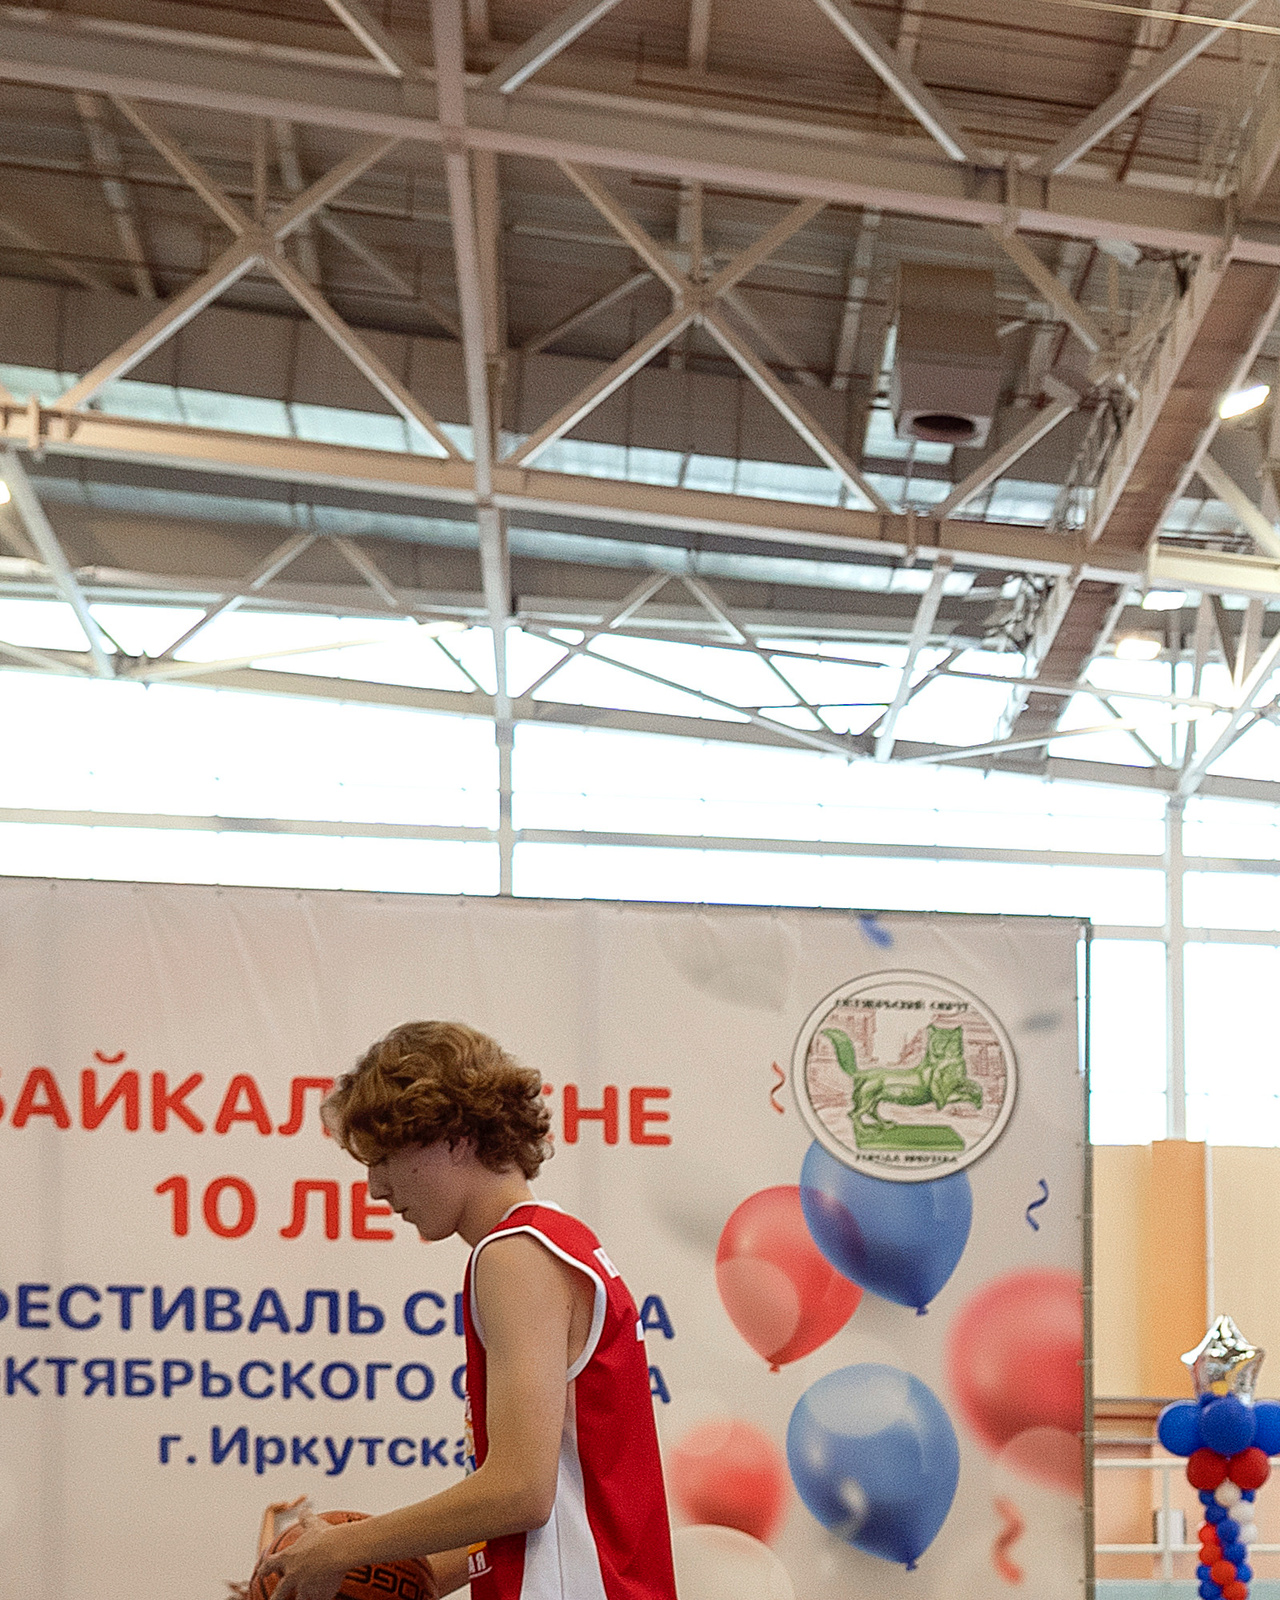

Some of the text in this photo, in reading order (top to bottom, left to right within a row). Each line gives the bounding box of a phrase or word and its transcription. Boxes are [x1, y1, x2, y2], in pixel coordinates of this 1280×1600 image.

[0, 1049, 334, 1138] АЙКАЛ
[156, 1176, 395, 1241] 10 ЛЕ
[4, 1356, 436, 1401] КТЯБРЬСКОГО
[158, 1434, 197, 1465] г.
